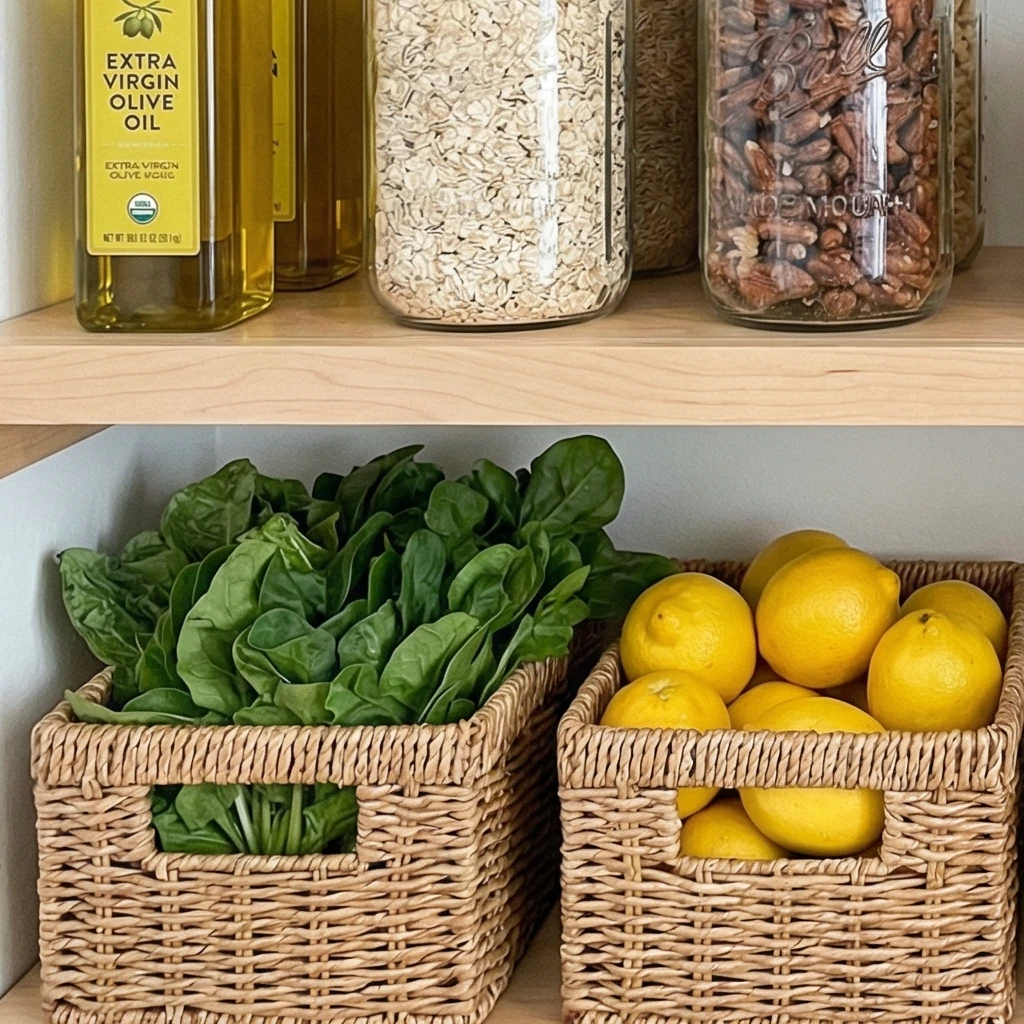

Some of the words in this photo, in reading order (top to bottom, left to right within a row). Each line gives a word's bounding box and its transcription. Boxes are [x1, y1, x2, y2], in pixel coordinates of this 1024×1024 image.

[106, 53, 178, 70] EXTRA
[102, 73, 180, 90] VIRGIN
[108, 93, 175, 111] OLIVE
[123, 113, 162, 132] OIL
